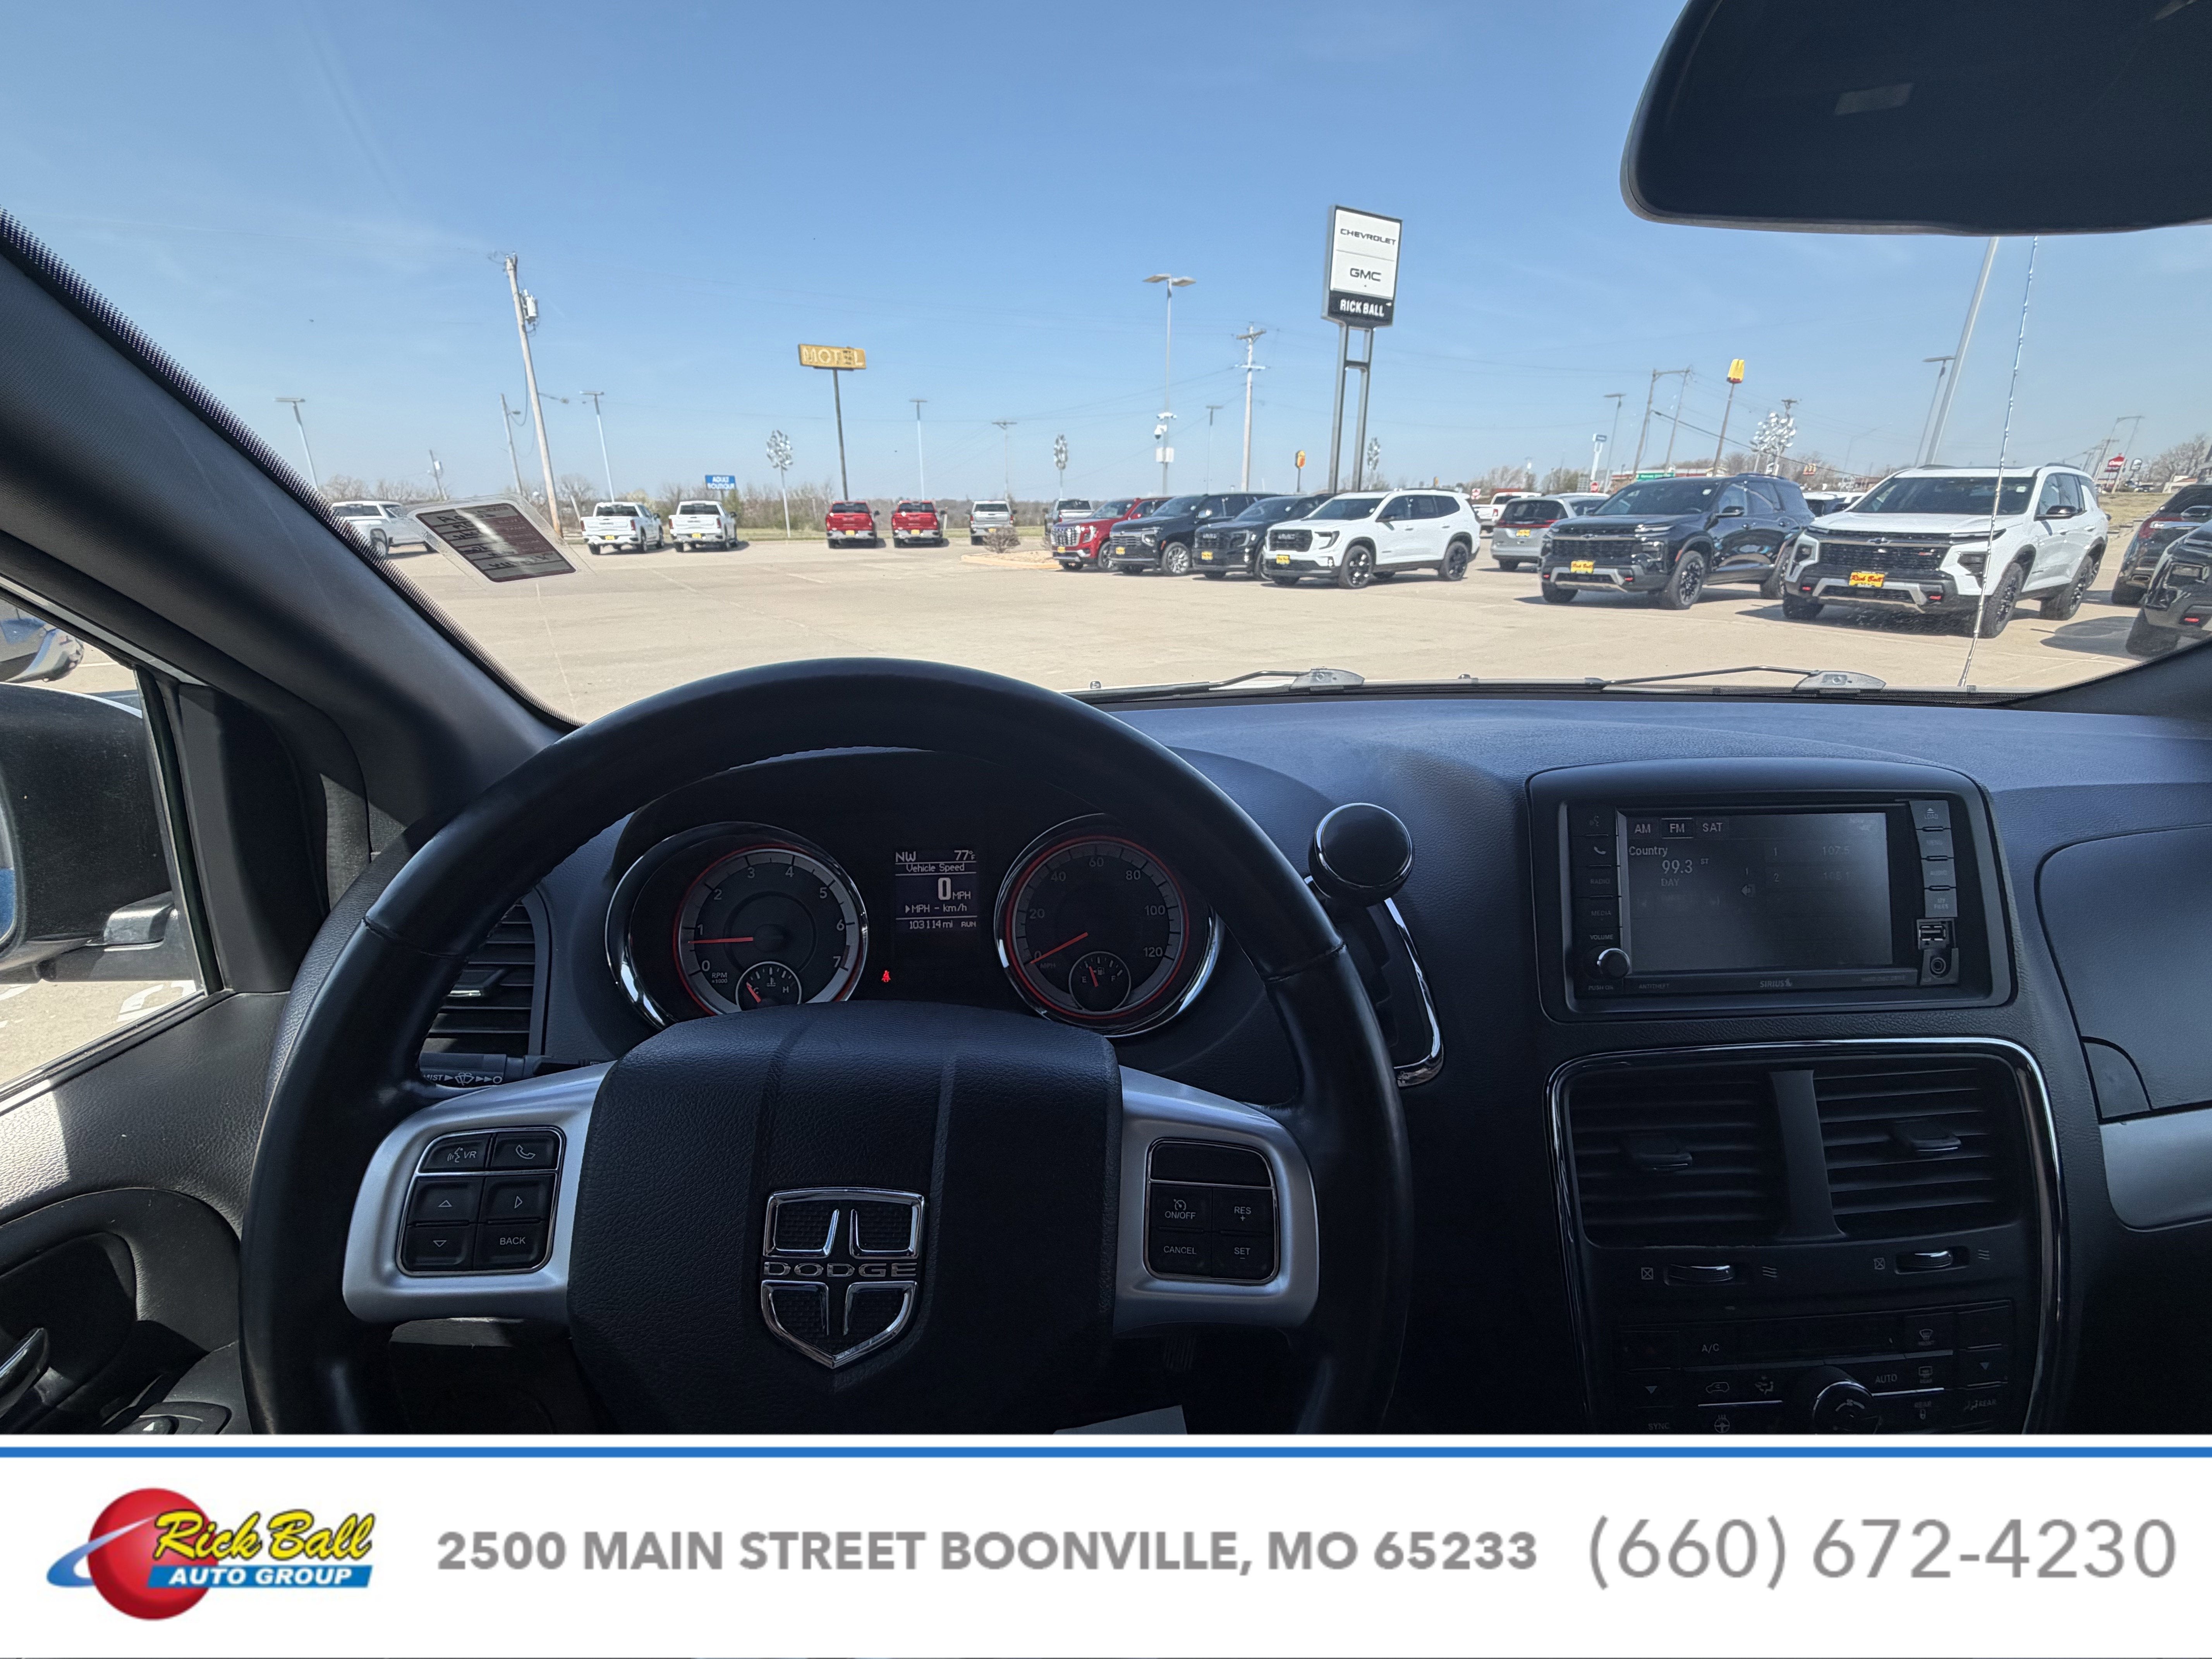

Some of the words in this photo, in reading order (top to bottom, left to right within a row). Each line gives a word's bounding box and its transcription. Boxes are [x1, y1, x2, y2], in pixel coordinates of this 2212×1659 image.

[1340, 228, 1396, 245] CHEVROLET
[1350, 268, 1382, 282] GMC
[1340, 299, 1362, 314] RICK
[1362, 302, 1384, 317] BALL
[802, 347, 863, 366] MOTEL
[1634, 824, 1651, 833] AM
[1669, 824, 1685, 833] FM
[1702, 823, 1723, 832] SAT
[895, 851, 916, 862] NW
[954, 850, 975, 861] 77°F
[1629, 846, 1668, 857] Country
[906, 864, 936, 872] Vehicle
[939, 863, 965, 872] Speed
[1089, 857, 1104, 867] 60
[1662, 859, 1693, 874] 99.3
[747, 868, 755, 879] 3
[785, 867, 794, 878] 4
[1051, 871, 1066, 882] 40
[1125, 870, 1141, 881] 80
[1774, 874, 1779, 882] 2
[1661, 878, 1680, 886] DAY
[819, 887, 828, 899] 5
[938, 877, 951, 900] 0
[952, 891, 971, 900] MPH
[713, 889, 722, 900] 2
[912, 904, 930, 913] MPH
[943, 903, 967, 912] km/h
[1029, 908, 1045, 919] 20
[1144, 905, 1166, 915] 100
[697, 924, 703, 935] 1
[836, 919, 845, 931] 6
[1143, 946, 1163, 958] 120
[701, 960, 711, 972] 0
[833, 955, 841, 967] 7
[1082, 975, 1087, 984] E
[1760, 980, 1785, 988] SIRIUS
[464, 1151, 477, 1159] VR
[1165, 1211, 1196, 1220] ON/OFF
[1234, 1206, 1252, 1214] RES
[500, 1237, 526, 1245] BACK
[1163, 1245, 1197, 1255] CANCEL
[1234, 1247, 1251, 1256] SET
[764, 1262, 917, 1278] DODGE
[1701, 1343, 1720, 1353] A/C
[1875, 1374, 1898, 1384] AUTO
[1648, 1422, 1670, 1431] SYNC
